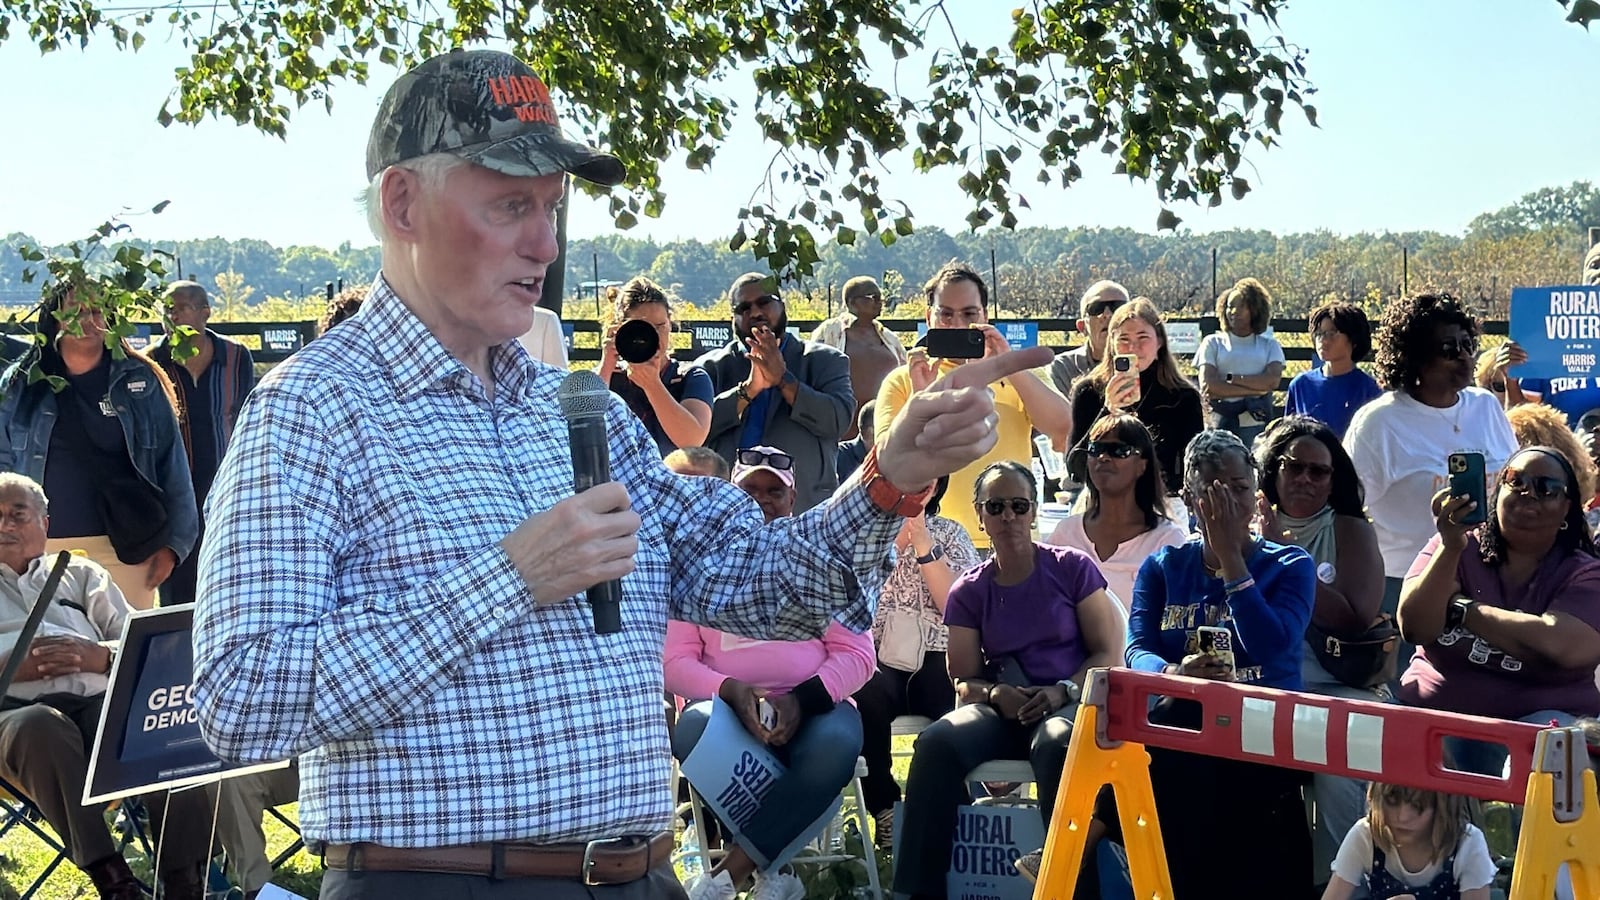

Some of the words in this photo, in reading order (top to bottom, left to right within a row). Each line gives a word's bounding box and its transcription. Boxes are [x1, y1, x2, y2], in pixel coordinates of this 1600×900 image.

[1550, 291, 1600, 315] RURA
[695, 327, 729, 340] HARRIS
[1545, 315, 1600, 340] VOTER
[264, 329, 298, 343] HARRIS
[270, 341, 293, 350] WALZ
[700, 339, 724, 348] WALZ
[1562, 353, 1596, 367] HARRIS
[1567, 365, 1592, 374] WALZ
[142, 707, 198, 732] DEMO
[733, 750, 776, 806] TERS
[953, 845, 1021, 877] OTERS
